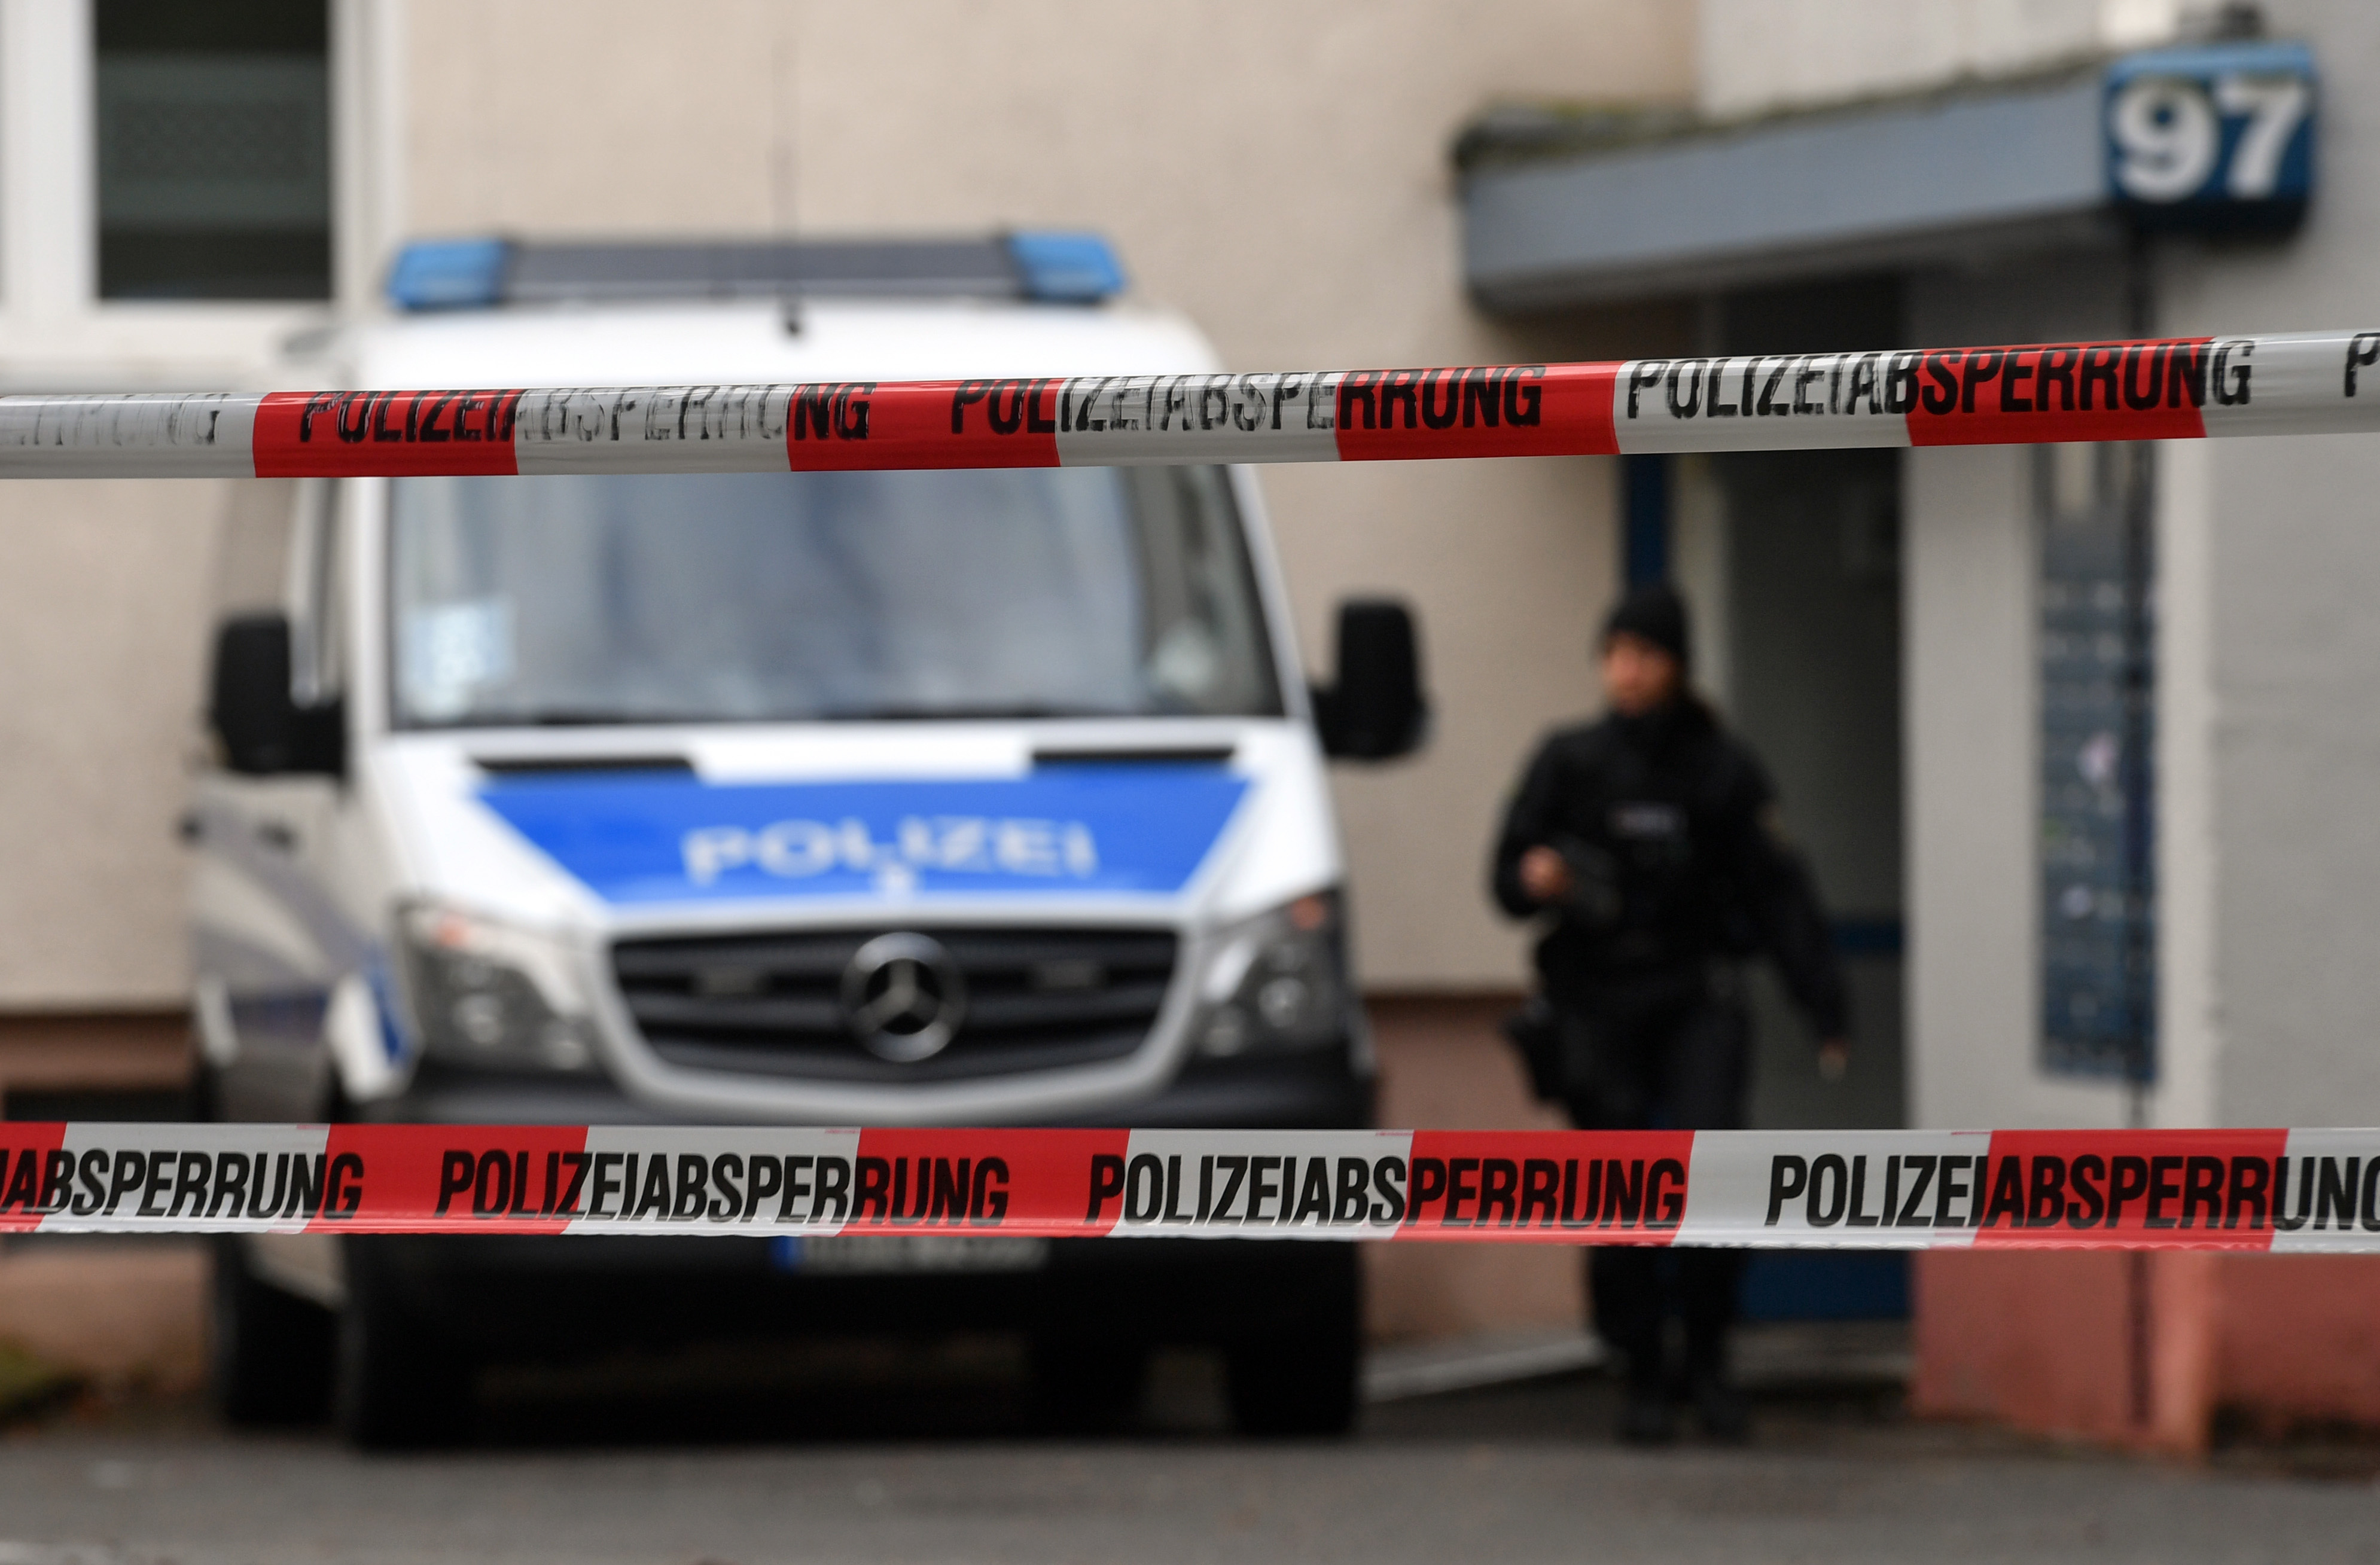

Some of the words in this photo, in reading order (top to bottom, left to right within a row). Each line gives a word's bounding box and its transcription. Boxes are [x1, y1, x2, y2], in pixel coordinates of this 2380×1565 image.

[2113, 73, 2304, 200] 97
[951, 365, 1546, 435] POLIZEIABSPERRUNG
[1627, 339, 2256, 419] POLIZEIABSPERRUNG
[680, 814, 1099, 886] POLIZEI
[432, 1148, 1010, 1226] POLIZEIABSPERRUNG
[1083, 1152, 1686, 1230] POLIZEIABSPERRUNG
